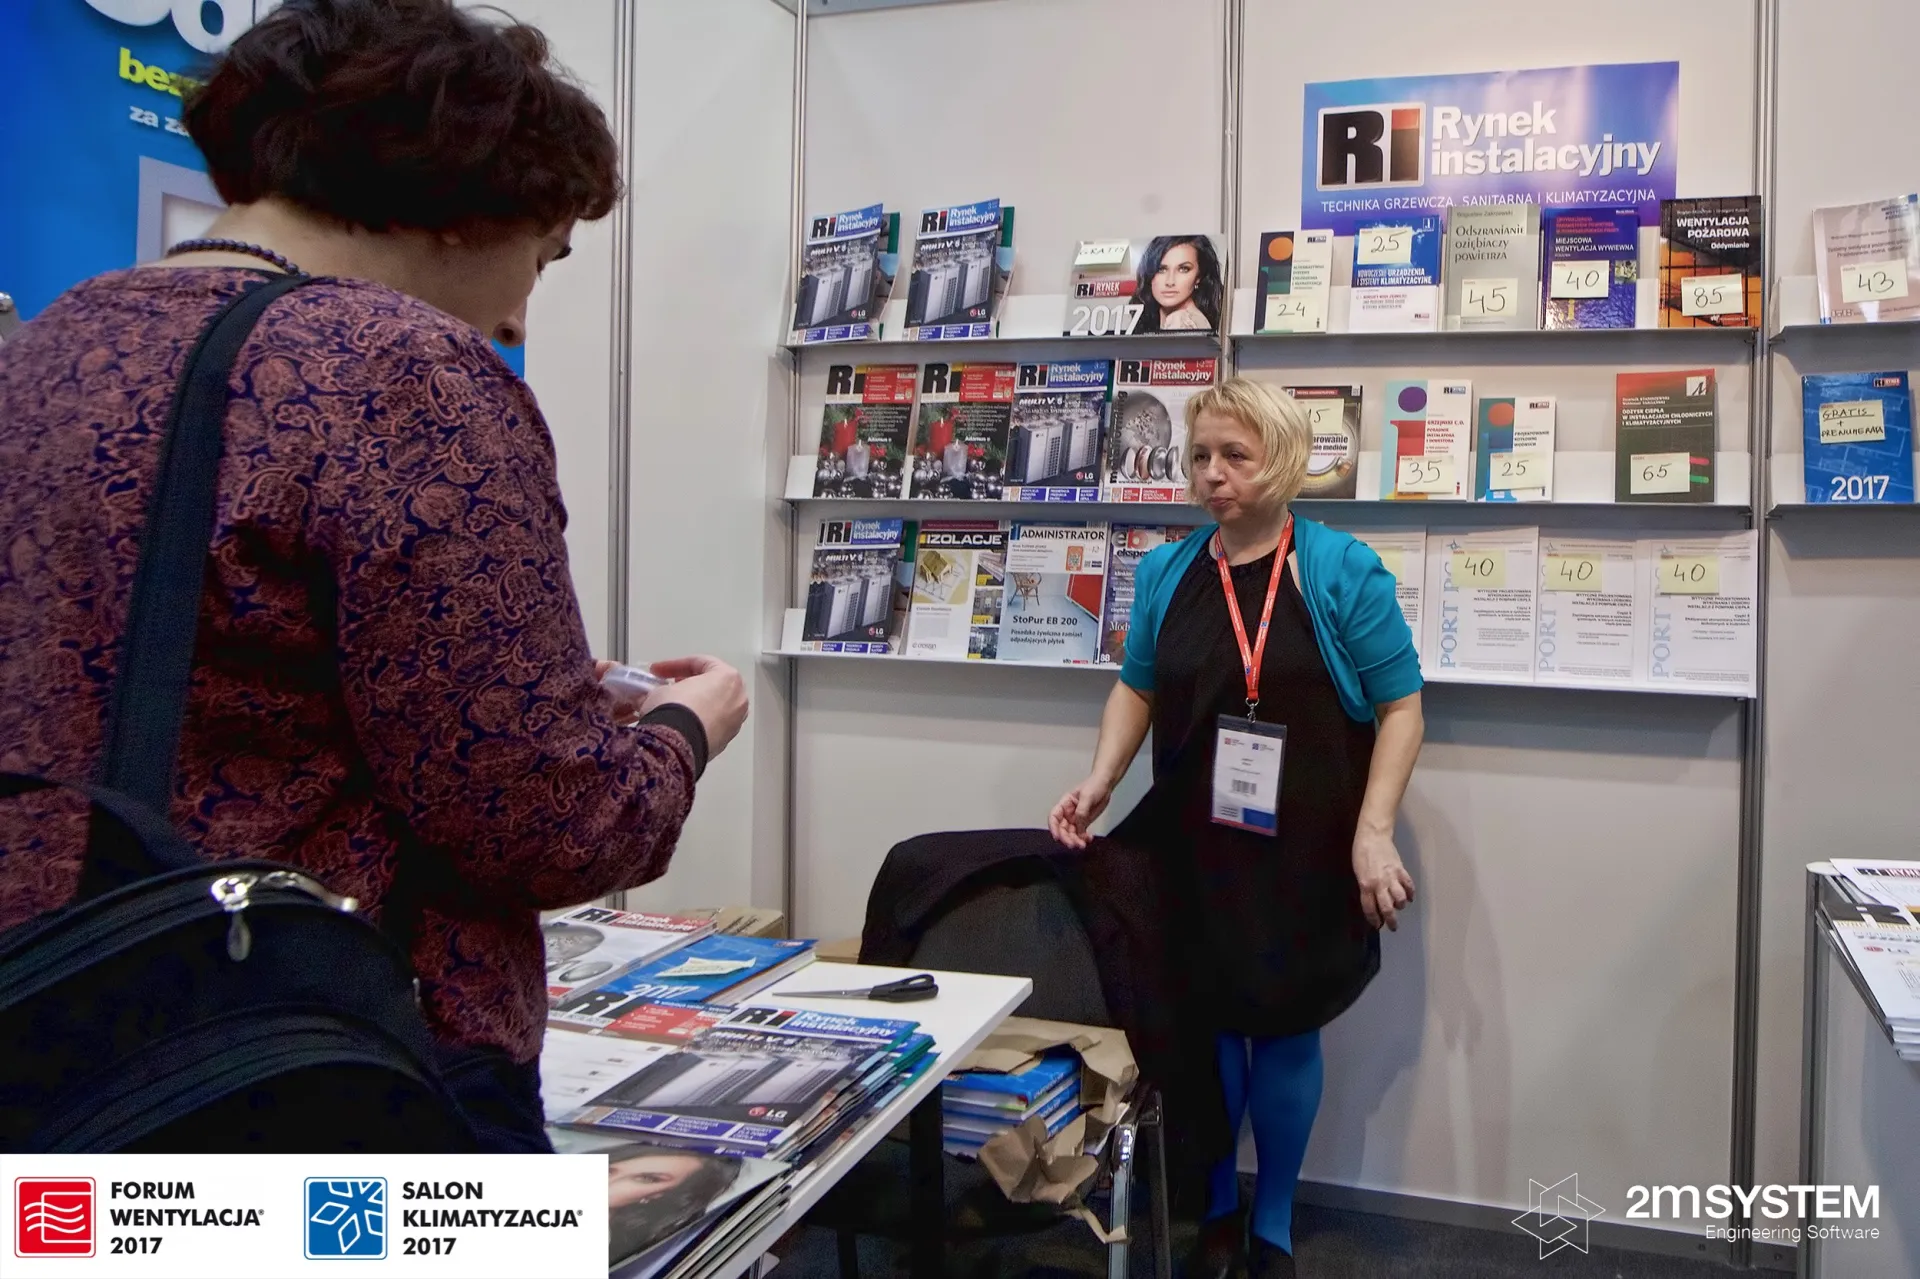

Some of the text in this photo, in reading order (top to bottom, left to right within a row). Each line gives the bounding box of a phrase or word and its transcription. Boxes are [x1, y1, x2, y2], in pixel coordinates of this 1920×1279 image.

[1431, 101, 1557, 145] Rynek
[1431, 133, 1662, 177] instalacyjny
[1321, 198, 1381, 213] TECHNIKA
[1463, 192, 1533, 207] SANITARNA
[1537, 193, 1542, 204] I
[1545, 188, 1656, 207] KLIMATYZACYJNA
[839, 211, 863, 224] Rynek
[949, 211, 996, 227] instalacyjny
[950, 205, 977, 219] Rynek
[1677, 216, 1750, 228] WENTYLACJA
[1687, 227, 1750, 239] POŻAROWA
[1371, 230, 1407, 254] 25
[1388, 268, 1425, 278] URZĄDZENIA
[1566, 270, 1600, 290] 40
[1096, 281, 1120, 292] RYNEK
[1381, 276, 1432, 285] KLIMATYZACYJNE
[1857, 271, 1894, 293] 43
[1469, 287, 1507, 313] 45
[1694, 286, 1727, 308] 85
[977, 309, 986, 317] LG
[1277, 302, 1306, 317] 24
[1070, 304, 1145, 336] 2017
[1051, 363, 1081, 374] Rynek
[1153, 361, 1186, 372] Rynek
[1050, 370, 1105, 383] instalacyjny
[1152, 369, 1212, 381] instalacyjny
[1020, 397, 1046, 405] MULTI
[1671, 411, 1713, 419] CHŁODNICZYCH
[1822, 408, 1867, 419] GRATIS
[1405, 460, 1443, 485] 35
[1501, 460, 1530, 477] 25
[1643, 463, 1672, 481] 65
[1084, 472, 1094, 480] LG
[1831, 475, 1889, 500] 2017
[855, 521, 880, 531] Rynek
[853, 529, 899, 540] instalacyjny
[926, 534, 1002, 545] IZOLACJE
[1021, 529, 1105, 540] ADMINISTRATOR
[1464, 557, 1494, 576] 40
[1560, 560, 1594, 582] 40
[1674, 563, 1706, 582] 40
[1012, 615, 1078, 626] StoPur EB 200
[875, 628, 884, 636] LG
[1440, 601, 1460, 669] PORT
[1538, 604, 1557, 673] PORT
[1652, 607, 1671, 678] PORT
[624, 983, 700, 999] 2017
[800, 1012, 858, 1025] Rynek
[790, 1020, 898, 1036] instalacyjny
[766, 1108, 788, 1118] LG
